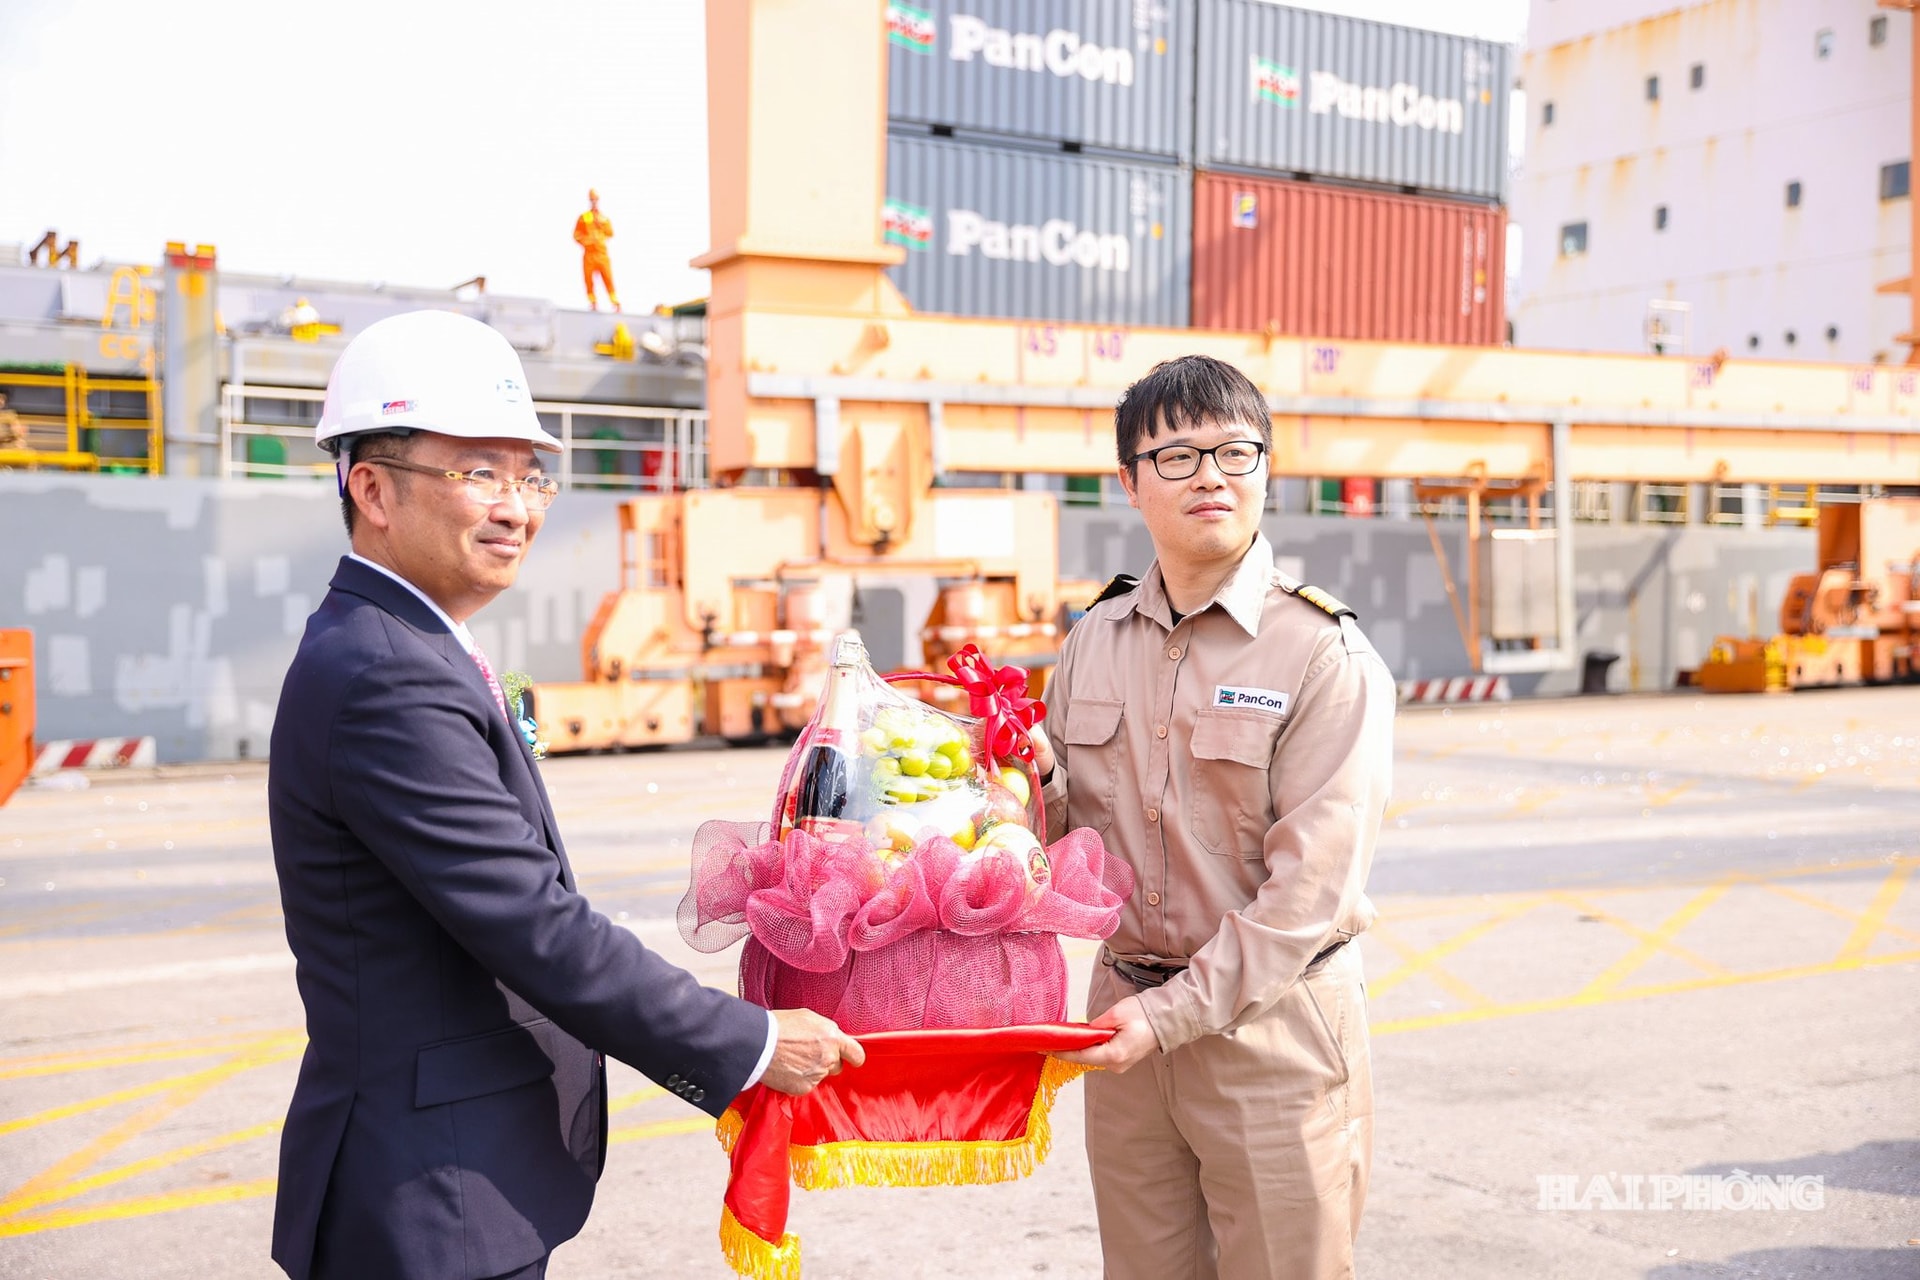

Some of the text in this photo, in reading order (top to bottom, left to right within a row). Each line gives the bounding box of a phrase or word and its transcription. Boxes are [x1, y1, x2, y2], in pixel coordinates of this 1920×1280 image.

[950, 14, 1134, 87] PanCon
[1309, 70, 1464, 135] PanCon
[947, 209, 1131, 272] PanCon
[1237, 693, 1283, 709] PanCon
